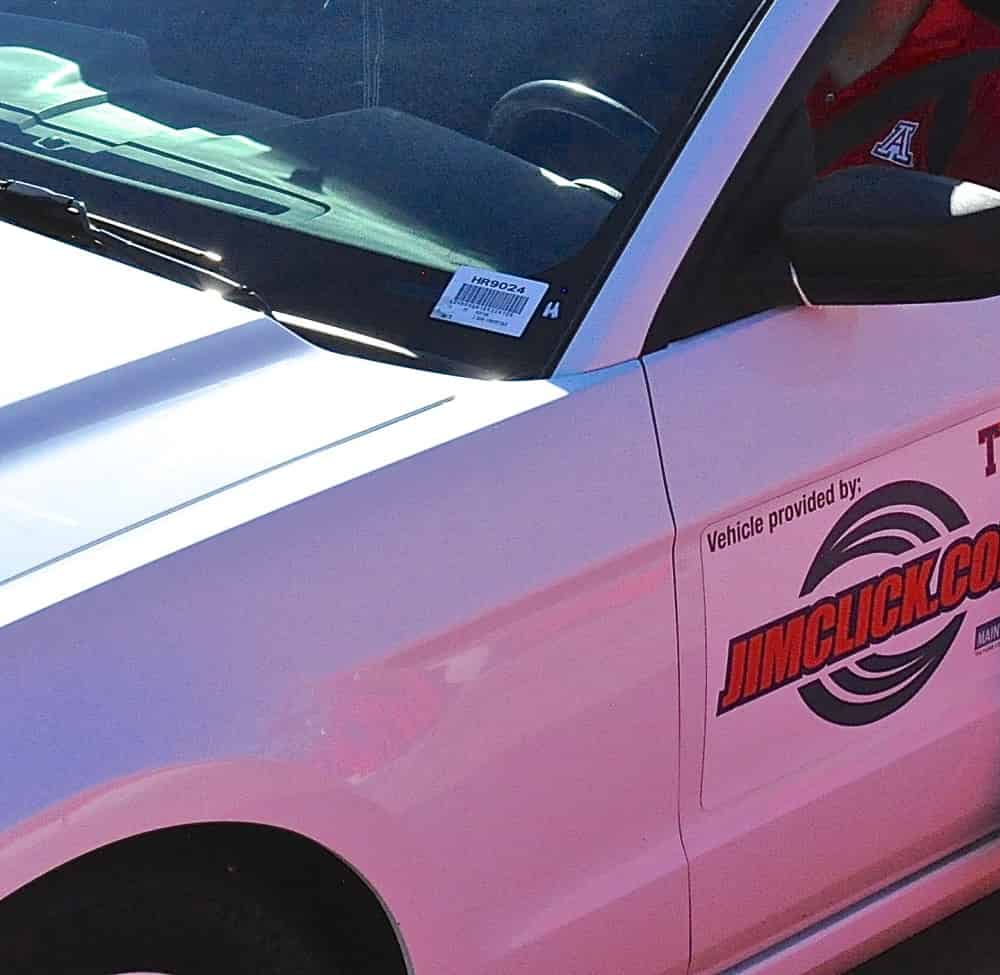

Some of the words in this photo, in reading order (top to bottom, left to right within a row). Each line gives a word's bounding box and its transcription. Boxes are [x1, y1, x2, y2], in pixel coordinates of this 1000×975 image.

[870, 120, 920, 168] A
[471, 275, 526, 295] HR9024
[707, 516, 764, 553] Vehicle
[768, 482, 835, 534] provided
[838, 476, 861, 500] by:
